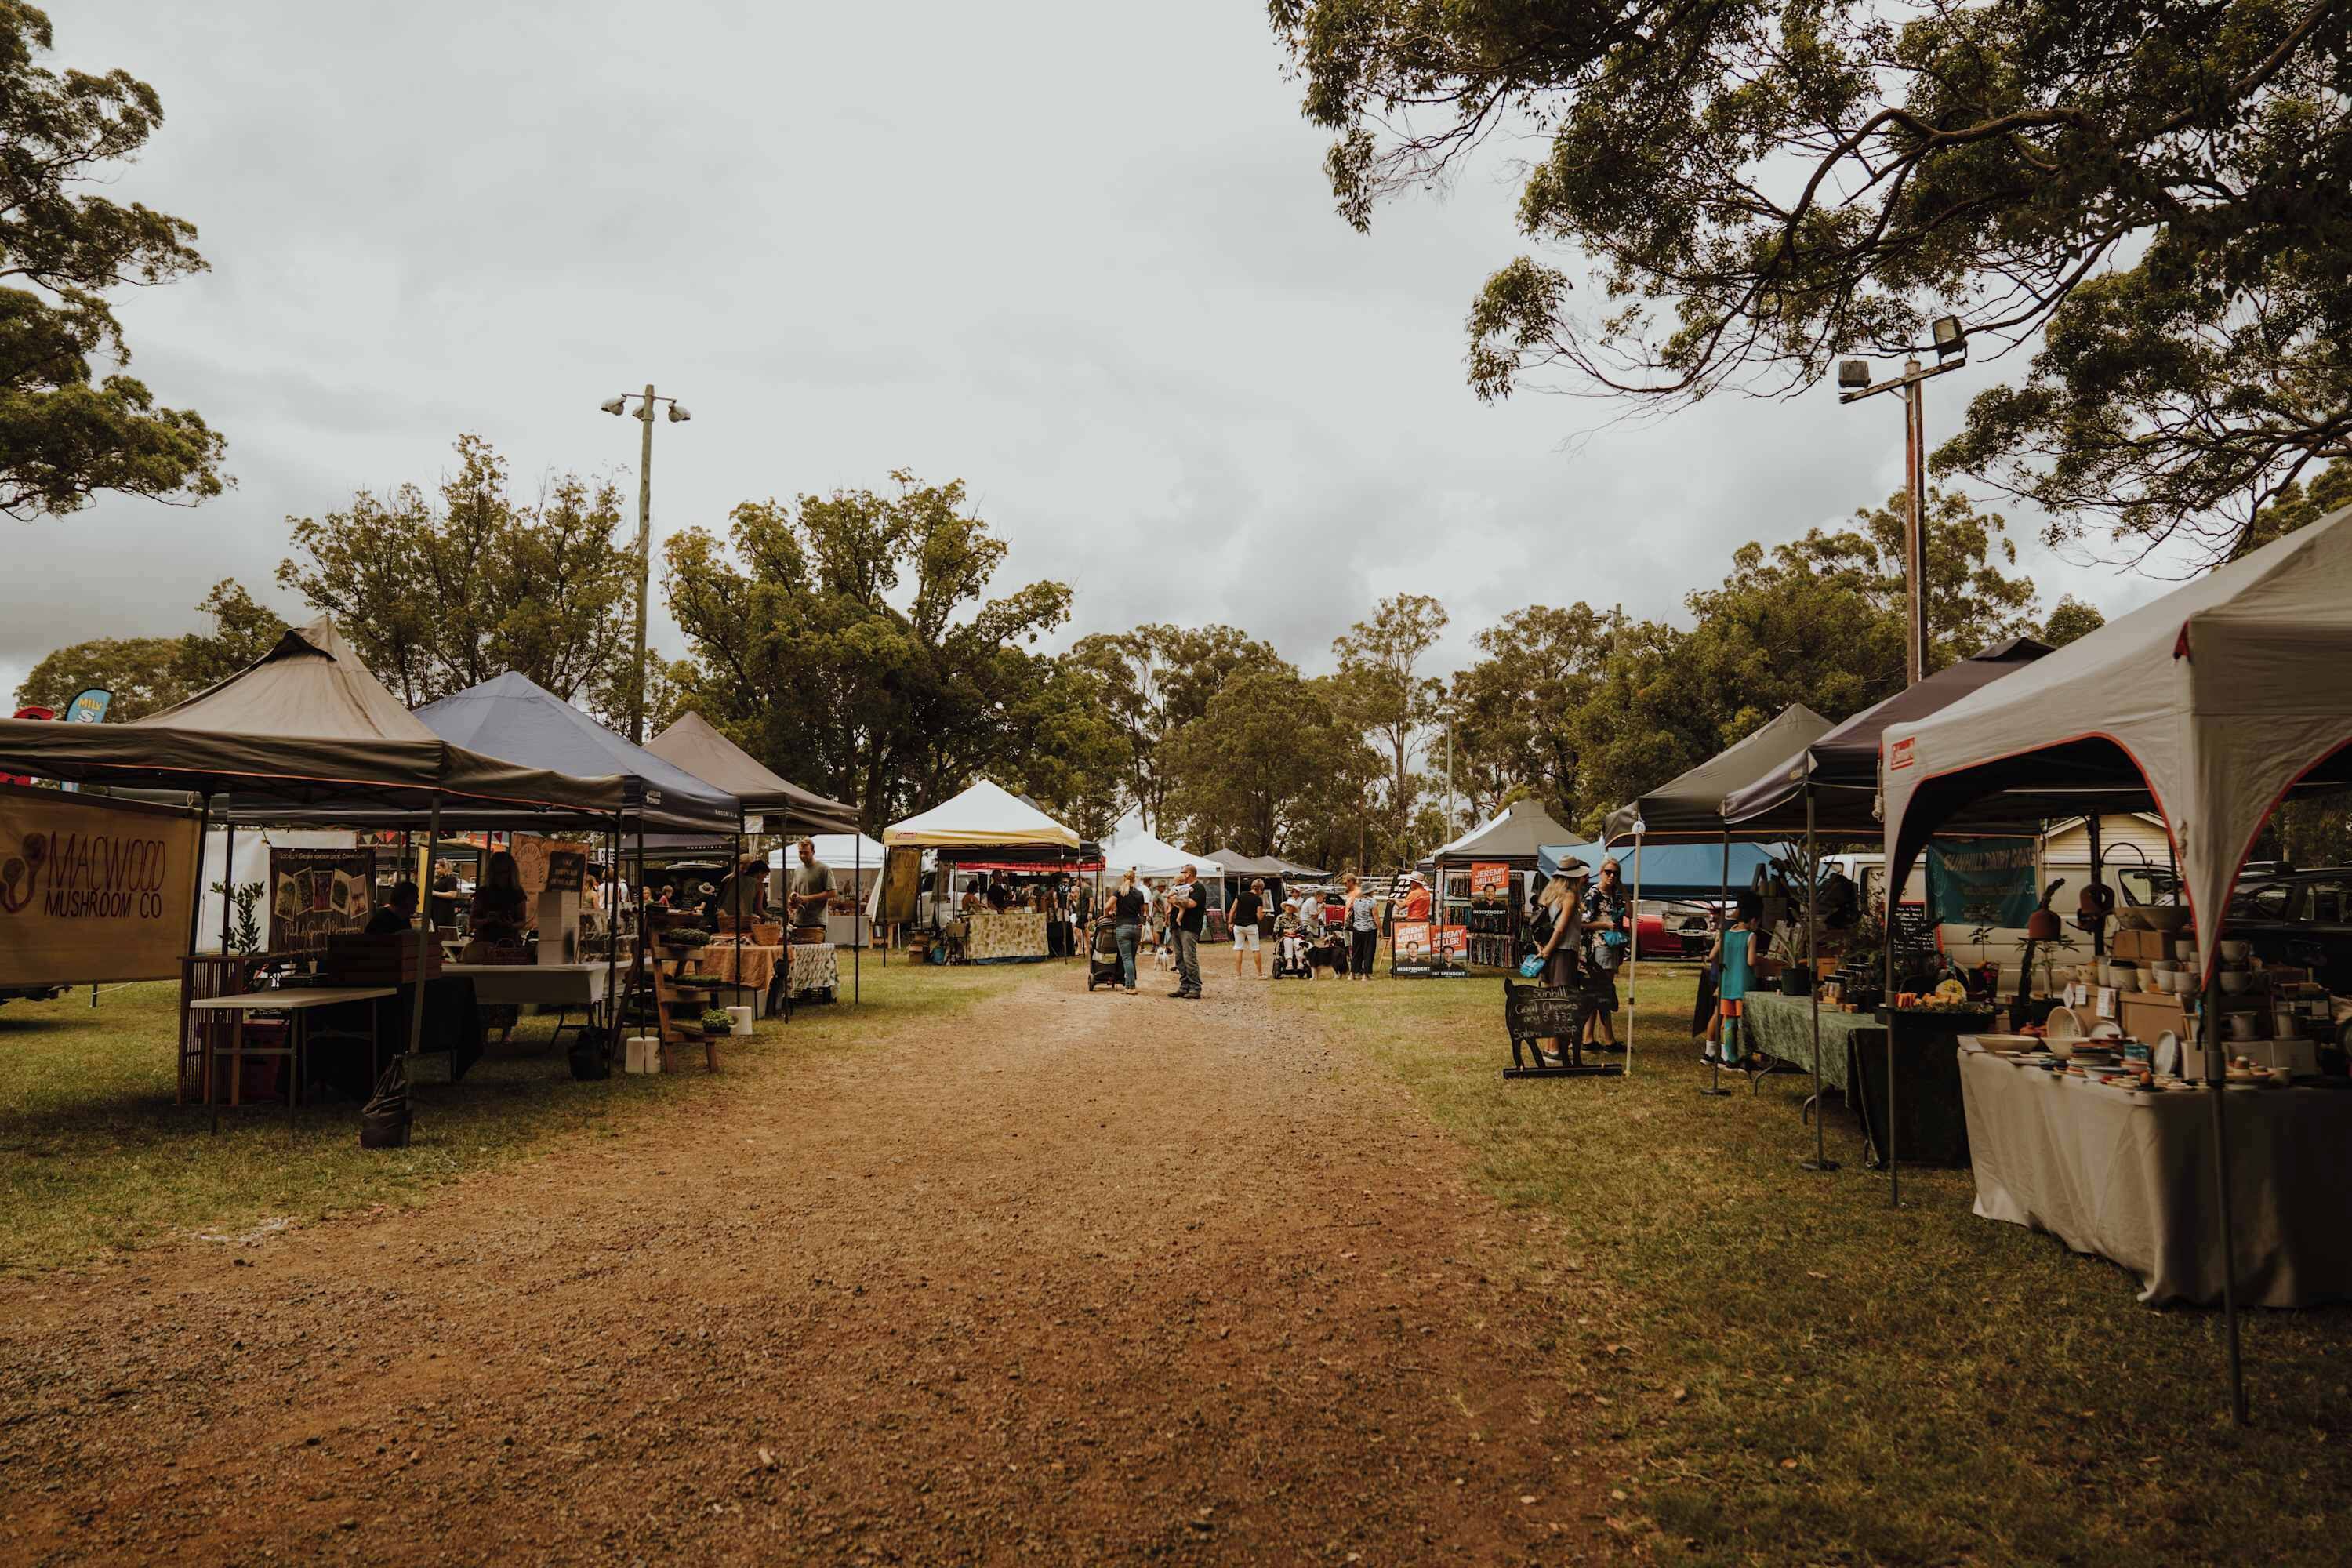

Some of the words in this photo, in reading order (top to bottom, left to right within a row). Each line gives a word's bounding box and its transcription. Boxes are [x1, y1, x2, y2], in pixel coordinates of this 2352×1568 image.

[48, 830, 166, 892] MACWOOD
[1475, 866, 1506, 879] JEREMY
[1474, 874, 1501, 886] MILLER
[45, 891, 132, 918] MUSHROOM
[140, 892, 162, 919] CO
[1399, 925, 1428, 936] JEREMY
[1434, 928, 1464, 941] JEREMY
[1397, 933, 1425, 944] MILLER
[1433, 937, 1460, 949] MLLER
[1532, 985, 1568, 999] Sunhill
[1542, 1001, 1579, 1012] Cheeses
[1513, 1027, 1543, 1040] Sala
